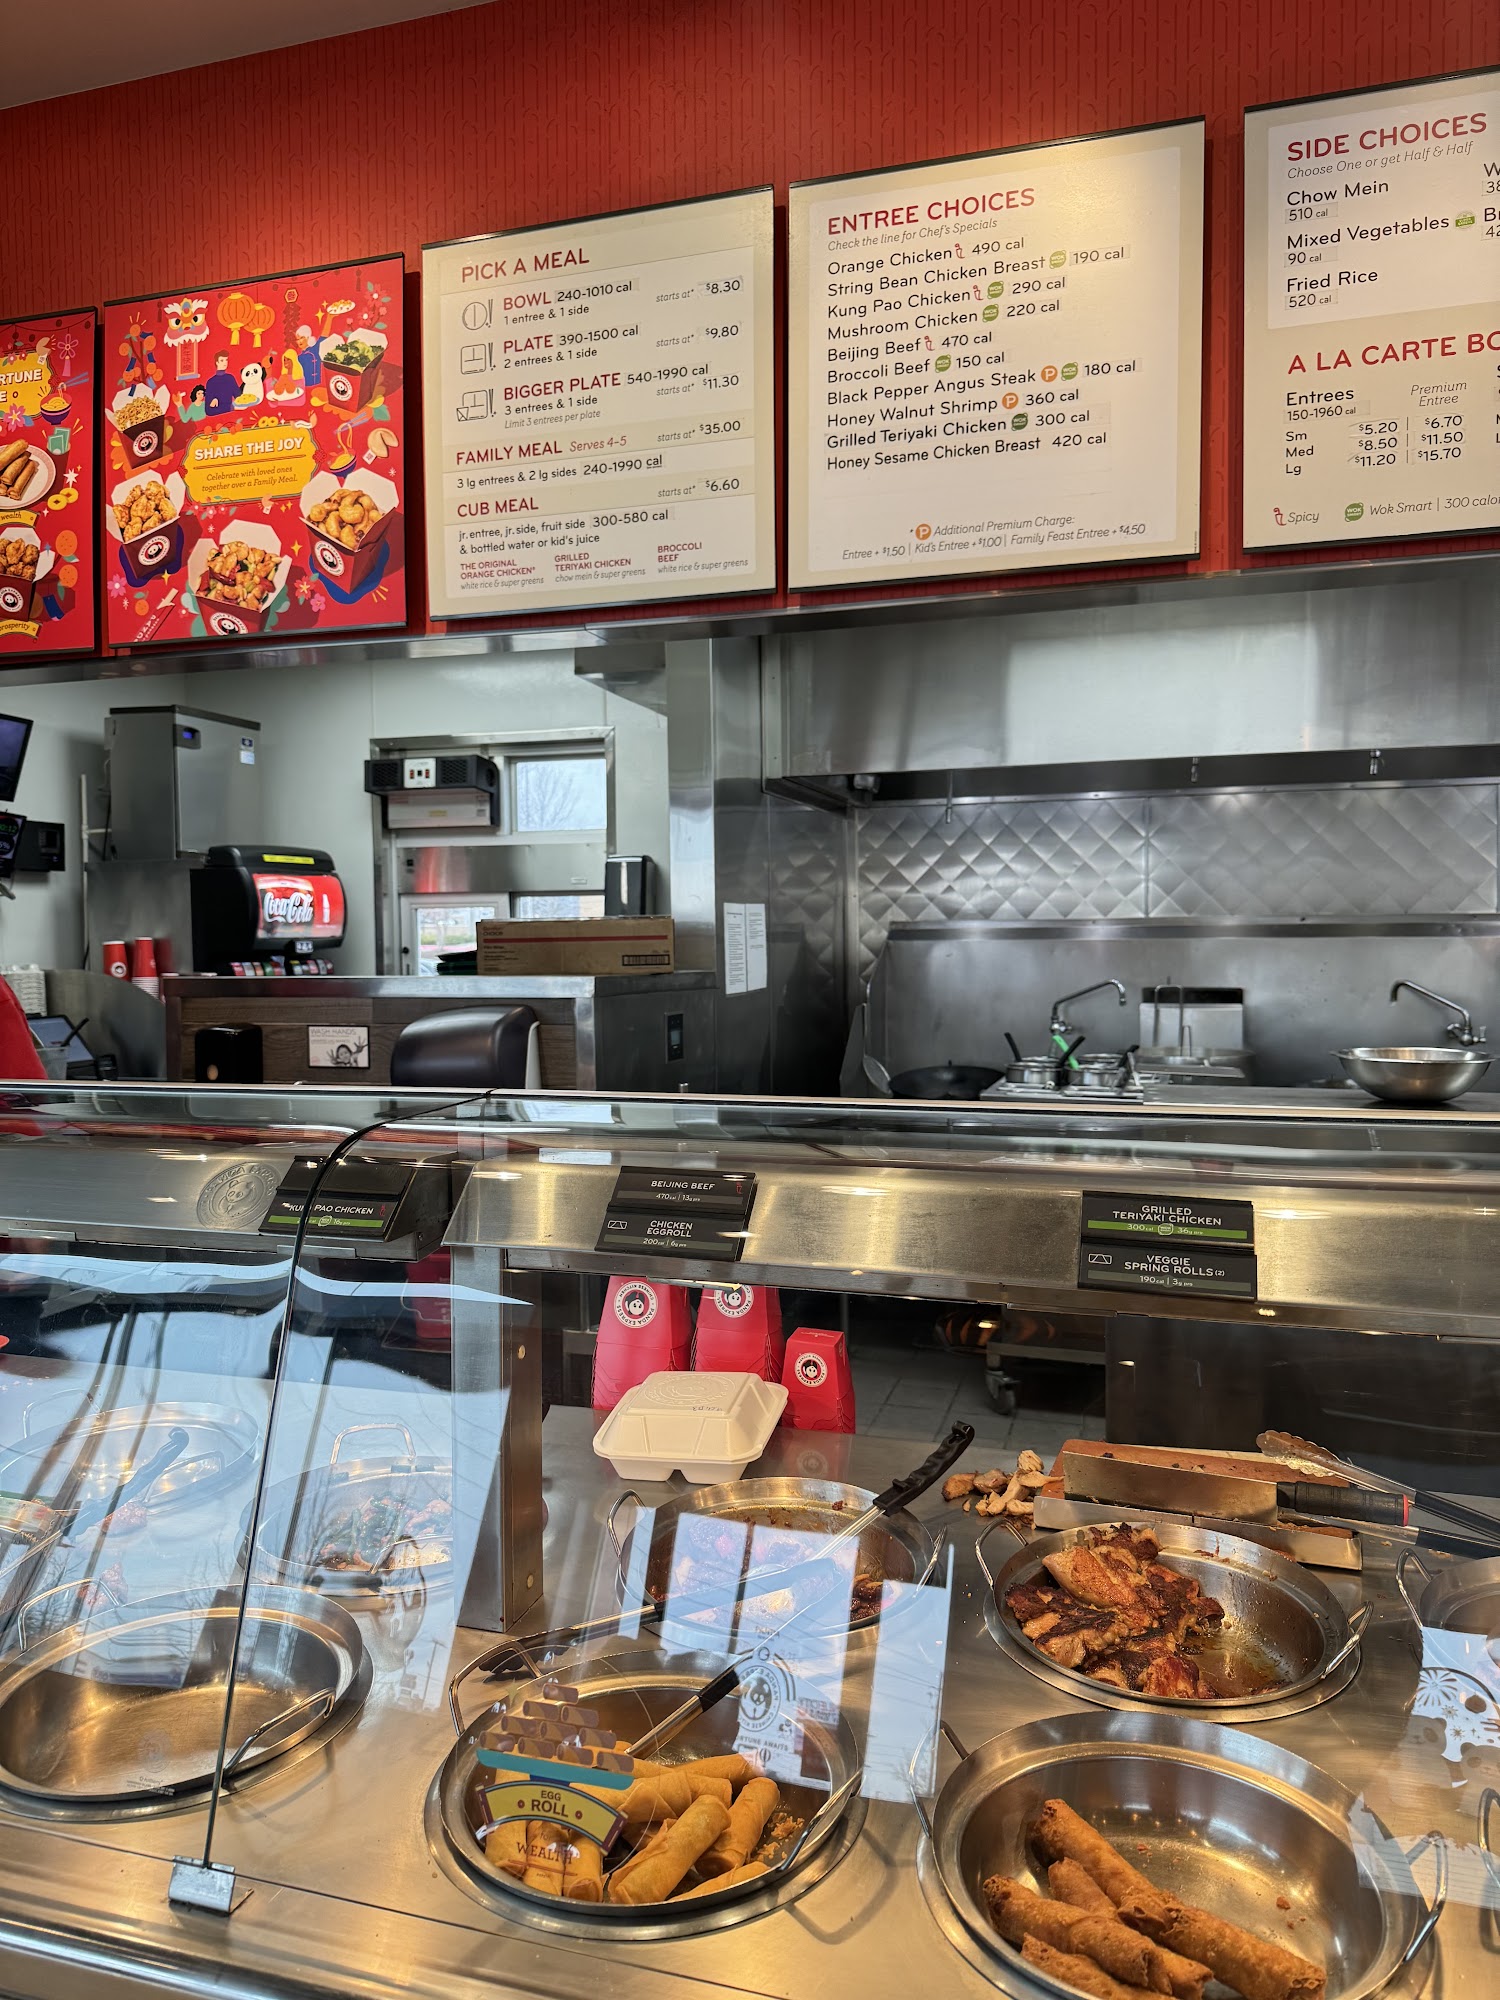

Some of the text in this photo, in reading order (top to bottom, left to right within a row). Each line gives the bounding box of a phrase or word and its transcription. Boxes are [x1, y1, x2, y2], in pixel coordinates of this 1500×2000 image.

[1288, 113, 1487, 161] SIDE CHOICES
[1288, 142, 1474, 179] Choose One or get Half & Half
[1287, 181, 1389, 205] Chow Mein
[828, 189, 1035, 235] ENTREE CHOICES
[1289, 207, 1328, 221] 510 cal
[828, 219, 997, 250] Check the line for Chef's Specials
[1288, 229, 1341, 249] Mixed
[1347, 217, 1449, 241] Vegetables
[461, 248, 589, 282] PICK A MEAL
[828, 237, 1024, 276] Orange Chicken 490 cal
[1288, 252, 1322, 265] 90 cal
[504, 281, 632, 310] BOWL 240-1010 cal
[706, 280, 741, 294] $8.30
[828, 277, 1065, 320] Kung Pao Chicken 290 cal
[512, 312, 544, 323] entree
[548, 310, 556, 319] &
[568, 305, 589, 316] side
[504, 325, 638, 354] PLATE 390-1500 cal
[705, 325, 739, 339] $9.80
[828, 332, 992, 362] Beijing Beef 470 cal
[1288, 337, 1456, 374] A LA CARTE
[504, 364, 709, 400] BIGGER PLATE 540-1990 cal
[703, 375, 739, 390] $11.30
[828, 361, 1136, 404] Black Pepper Angus Steak 180 cal
[1287, 382, 1467, 406] Entrees Premium
[1419, 396, 1458, 406] Entree
[1288, 406, 1343, 420] 150-1960
[699, 421, 741, 435] $35.00
[827, 411, 1090, 449] Grilled Teriyaki Chicken 300 cal
[1359, 416, 1462, 435] $5.20 $6.70
[1286, 432, 1307, 441] Sm
[1359, 432, 1463, 450] $8.50 $11.50
[195, 437, 304, 460] SHARE THE JOY
[456, 436, 627, 465] FAMILY MEAL Serves 4-5
[1286, 446, 1314, 457] Med
[1355, 447, 1461, 466] $11.20 $15.70
[207, 472, 239, 481] Celebrate
[257, 467, 275, 476] loved
[583, 455, 662, 476] 240-1990 cal
[1286, 464, 1301, 475] Lg
[202, 483, 230, 492] together
[253, 478, 277, 486] Family
[706, 478, 740, 492] $6.60
[458, 498, 539, 517] CUB MEAL
[1288, 497, 1469, 524] Spicy Wok Smart 300
[593, 510, 668, 527] 300-580 cal
[934, 515, 1074, 537] Additional Premium Charge:
[658, 543, 702, 553] BROCCOLI
[461, 559, 517, 570] THE ORIGINAL
[555, 553, 589, 562] GRILLED
[555, 559, 631, 572] TERIYAKI CHICKEN
[658, 554, 679, 562] BEEF
[335, 1206, 374, 1214] CHICKEN
[1113, 1211, 1222, 1225] TERIYAKI CHICKEN
[1142, 1205, 1191, 1215] GRILLED
[647, 1228, 691, 1237] EGGROLL
[650, 1221, 693, 1229] CHICKEN
[1125, 1262, 1213, 1276] SPRING ROLLS
[1146, 1255, 1190, 1265] VEGGIE
[617, 1306, 636, 1325] EXPRESS
[638, 1308, 654, 1324] PANDA
[541, 1790, 561, 1801] EGG
[531, 1799, 568, 1817] ROLL
[516, 1842, 572, 1864] WEALTH
